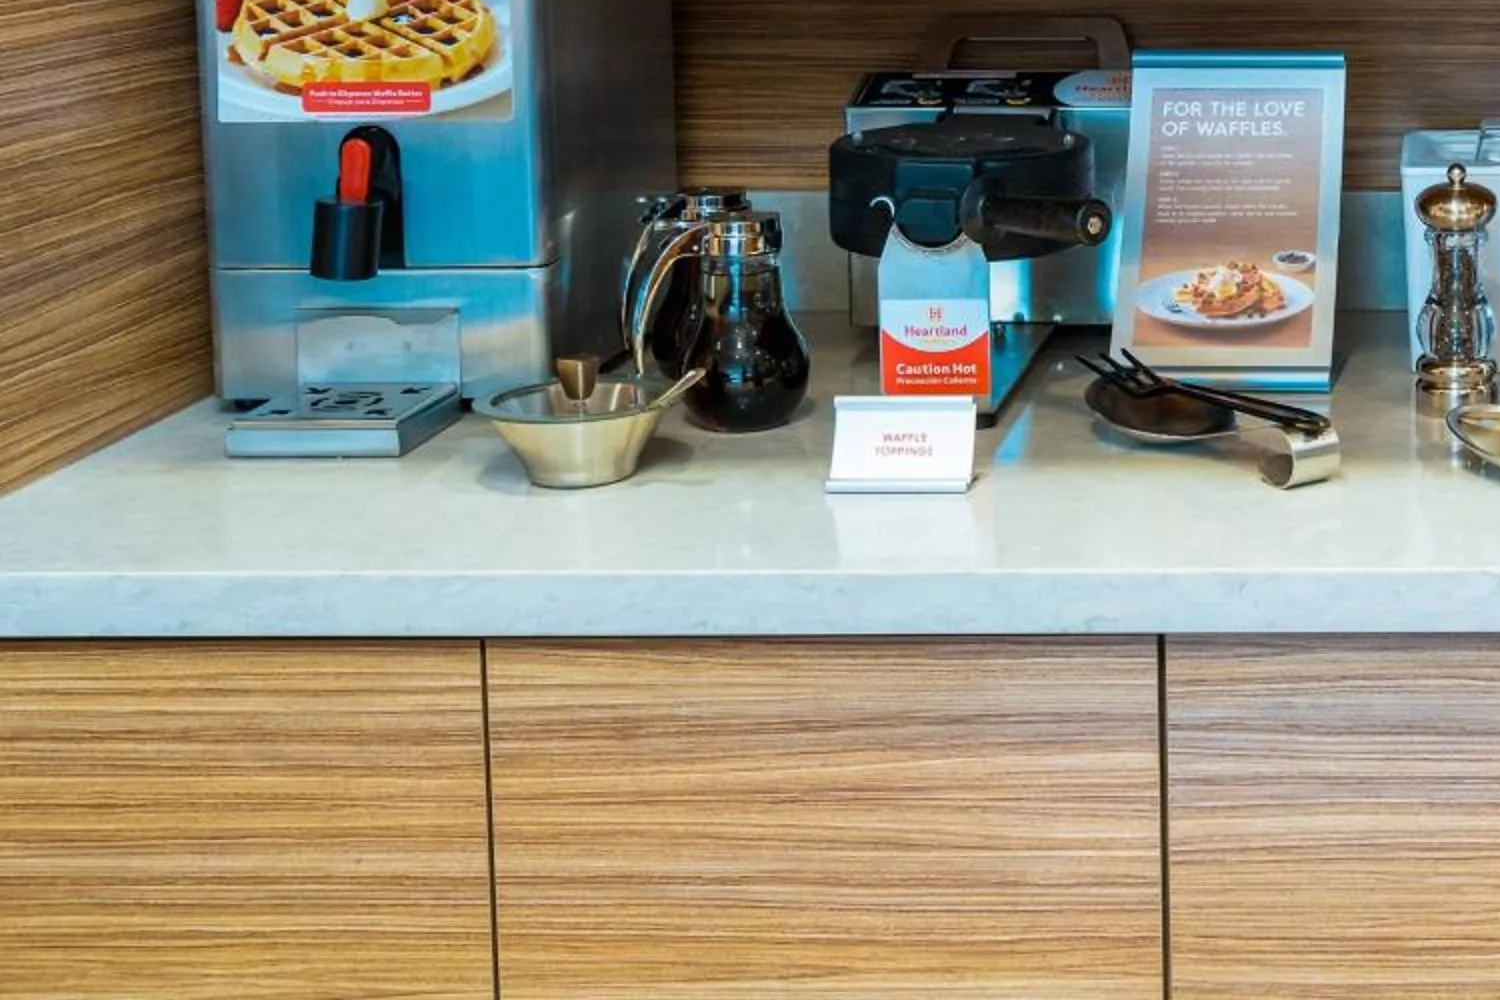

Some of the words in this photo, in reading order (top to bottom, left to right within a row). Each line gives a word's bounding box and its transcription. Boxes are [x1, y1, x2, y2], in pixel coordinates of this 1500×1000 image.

[1162, 101, 1202, 117] FOR
[1211, 101, 1246, 117] THE
[1254, 101, 1306, 117] LOVE
[1161, 121, 1190, 137] OF
[904, 325, 967, 336] Heartland
[896, 363, 951, 375] Caution
[952, 363, 977, 375] Hot
[882, 432, 928, 443] WAFFLE
[874, 445, 933, 457] TOPPINGS
